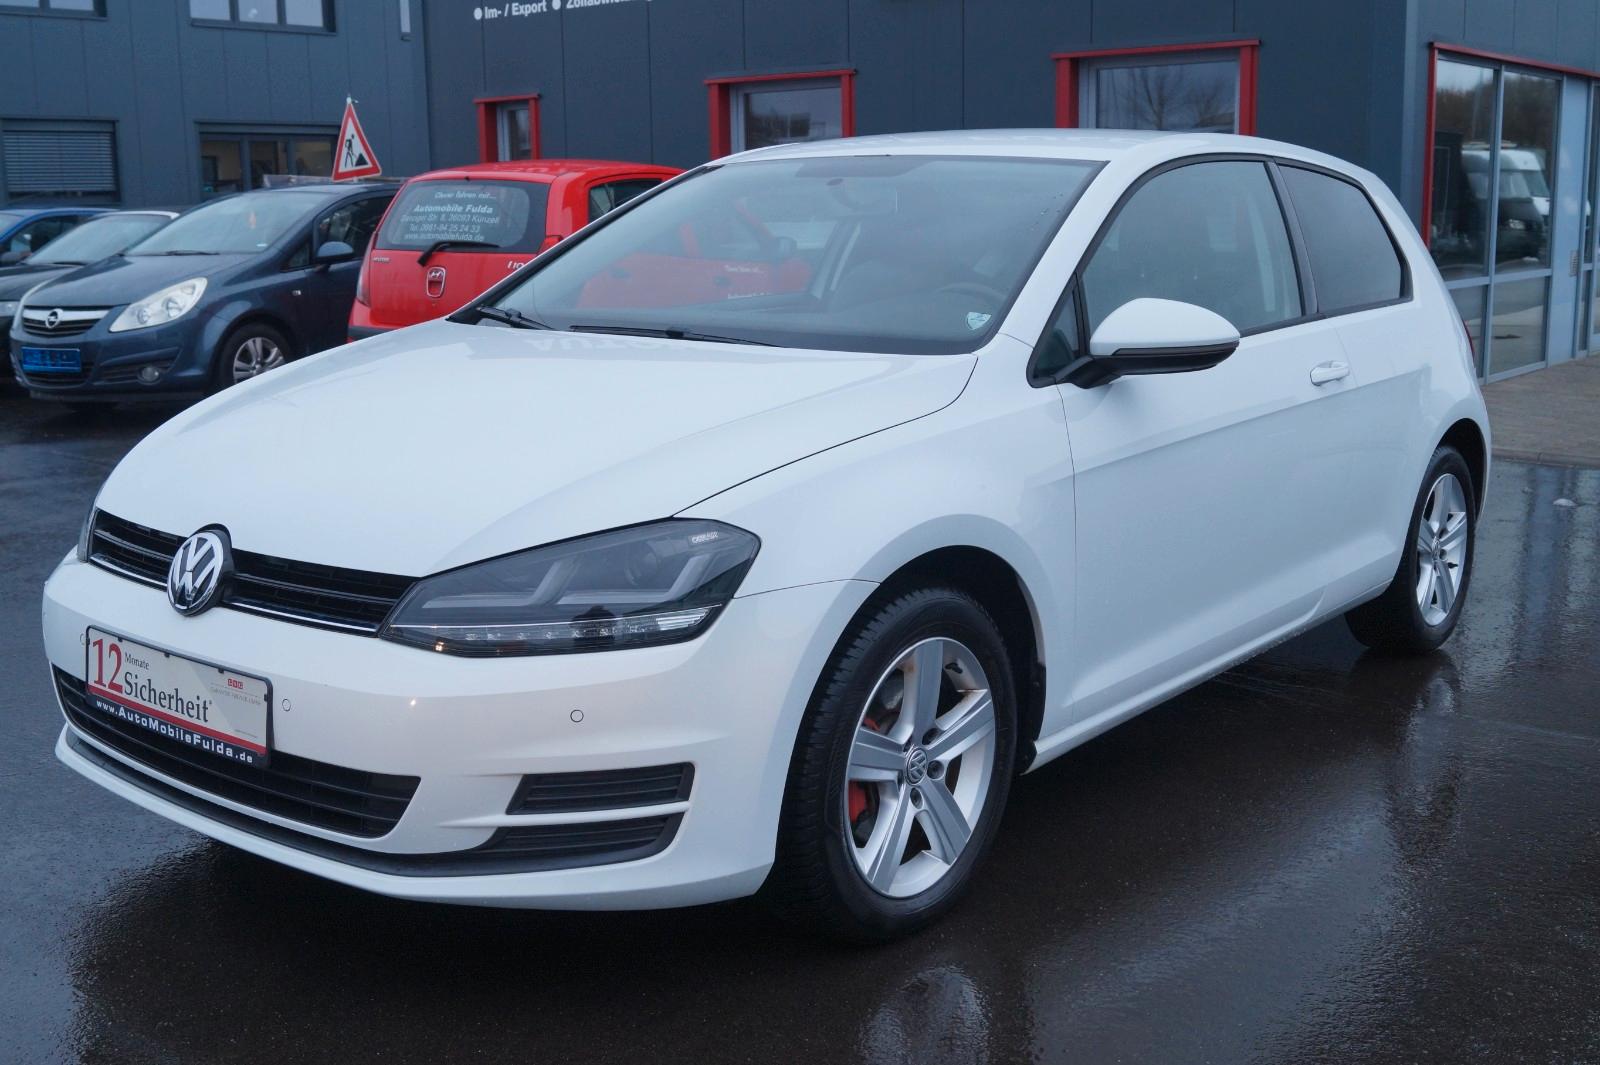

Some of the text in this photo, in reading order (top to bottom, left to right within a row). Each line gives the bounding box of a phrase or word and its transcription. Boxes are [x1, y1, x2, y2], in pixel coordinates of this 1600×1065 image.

[511, 1, 548, 17] Export
[413, 204, 494, 214] Automobile Fulda
[92, 638, 150, 694] 12 Monate
[96, 700, 253, 763] www.AutoMobileFulda.de
